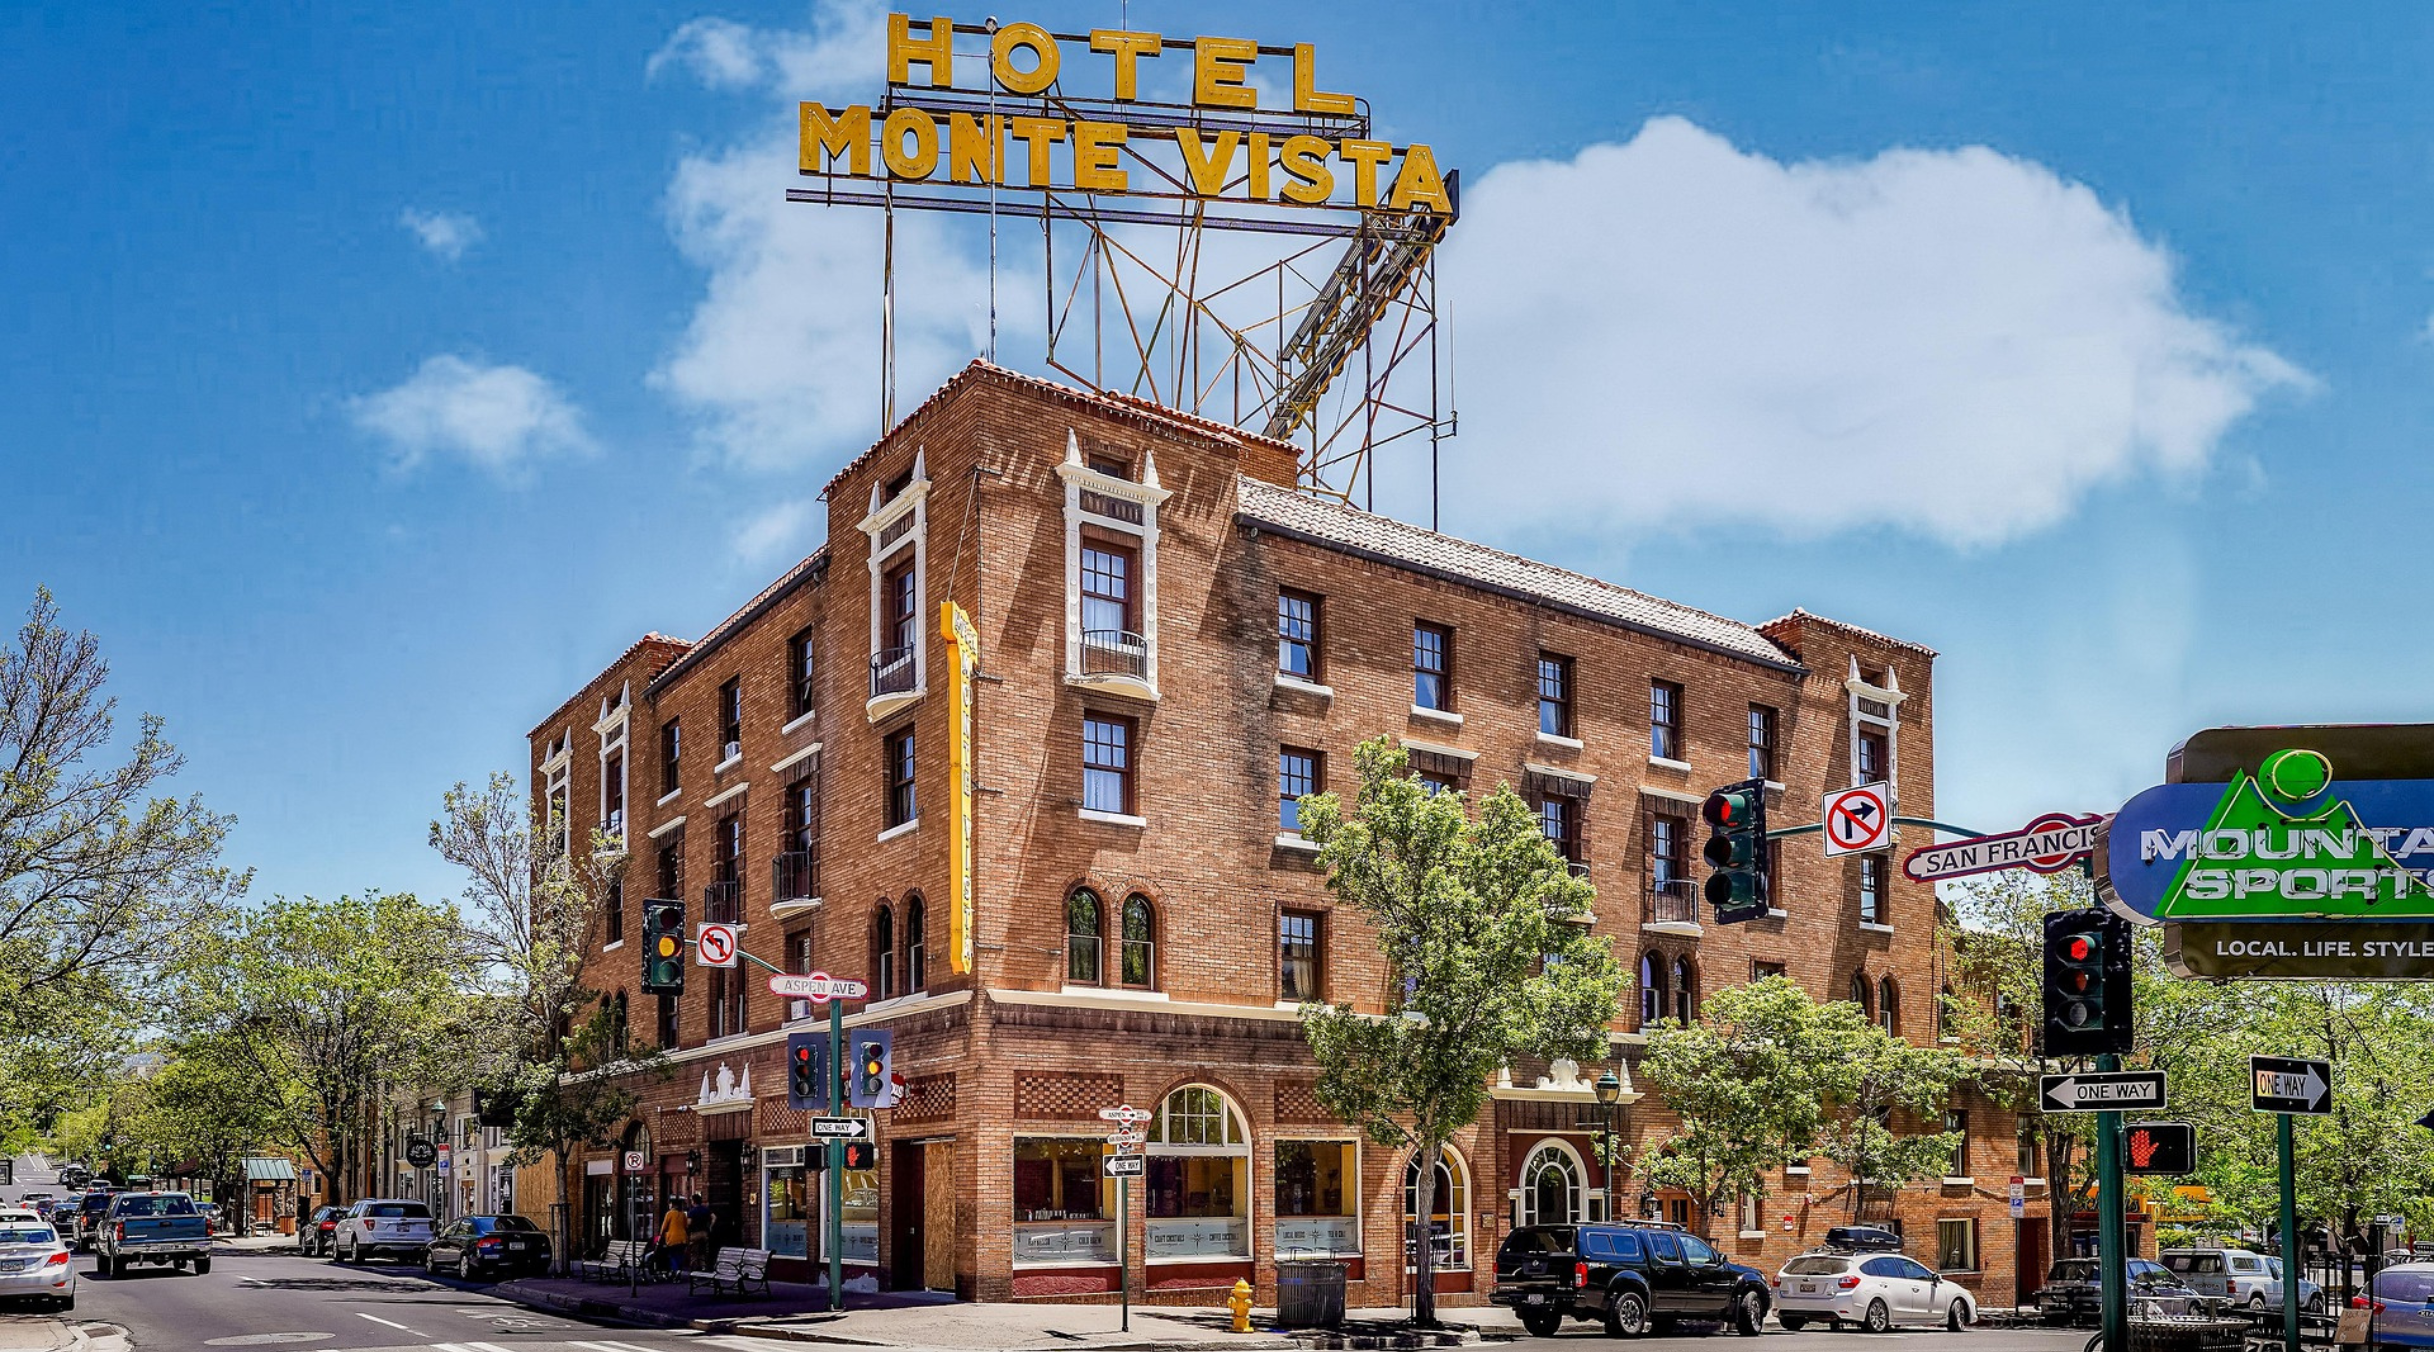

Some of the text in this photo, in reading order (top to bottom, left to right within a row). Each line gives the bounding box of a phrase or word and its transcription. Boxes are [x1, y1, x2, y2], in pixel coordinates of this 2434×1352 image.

[887, 13, 1356, 116] HOTEL
[799, 101, 1454, 215] MONTE VISTA
[1926, 847, 1978, 873] SAN
[2185, 868, 2434, 900] SPORT
[2216, 940, 2434, 957] LOCAL. LIFE. STYLE
[784, 979, 857, 995] ASPEN AVE
[2077, 1084, 2151, 1099] ONE WAY
[2259, 1073, 2307, 1097] ONE WAY
[817, 1122, 851, 1132] ONE WAY
[1115, 1161, 1139, 1170] ONE WAY
